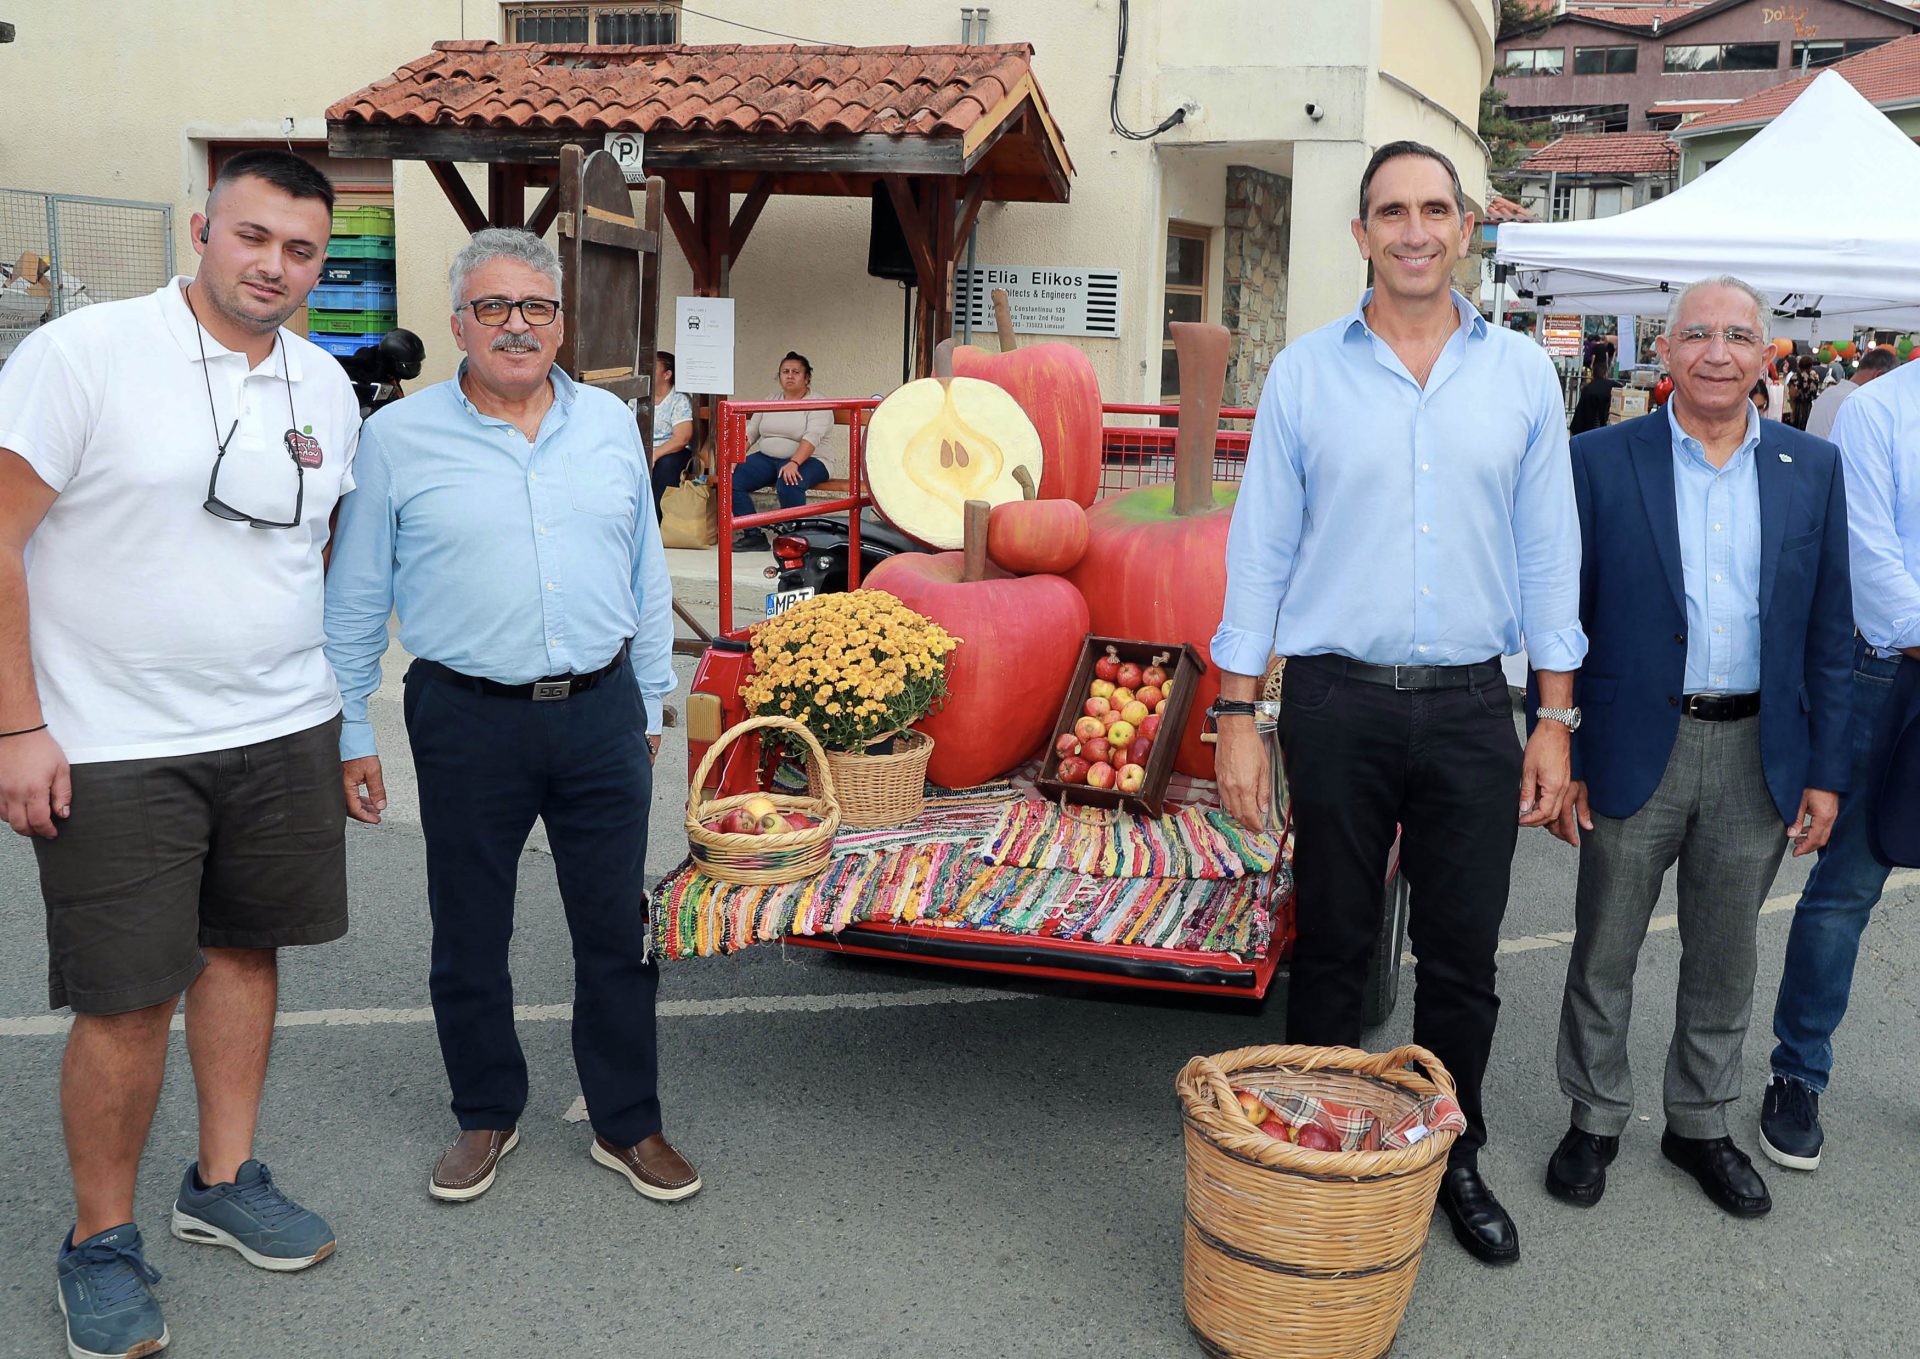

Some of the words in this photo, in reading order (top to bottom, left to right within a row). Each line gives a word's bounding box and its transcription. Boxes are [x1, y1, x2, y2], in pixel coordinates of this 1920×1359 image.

[619, 142, 633, 162] P
[988, 270, 1018, 284] Elia
[1032, 271, 1083, 287] Elikos
[1033, 290, 1038, 298] &
[1041, 290, 1077, 300] Engineers
